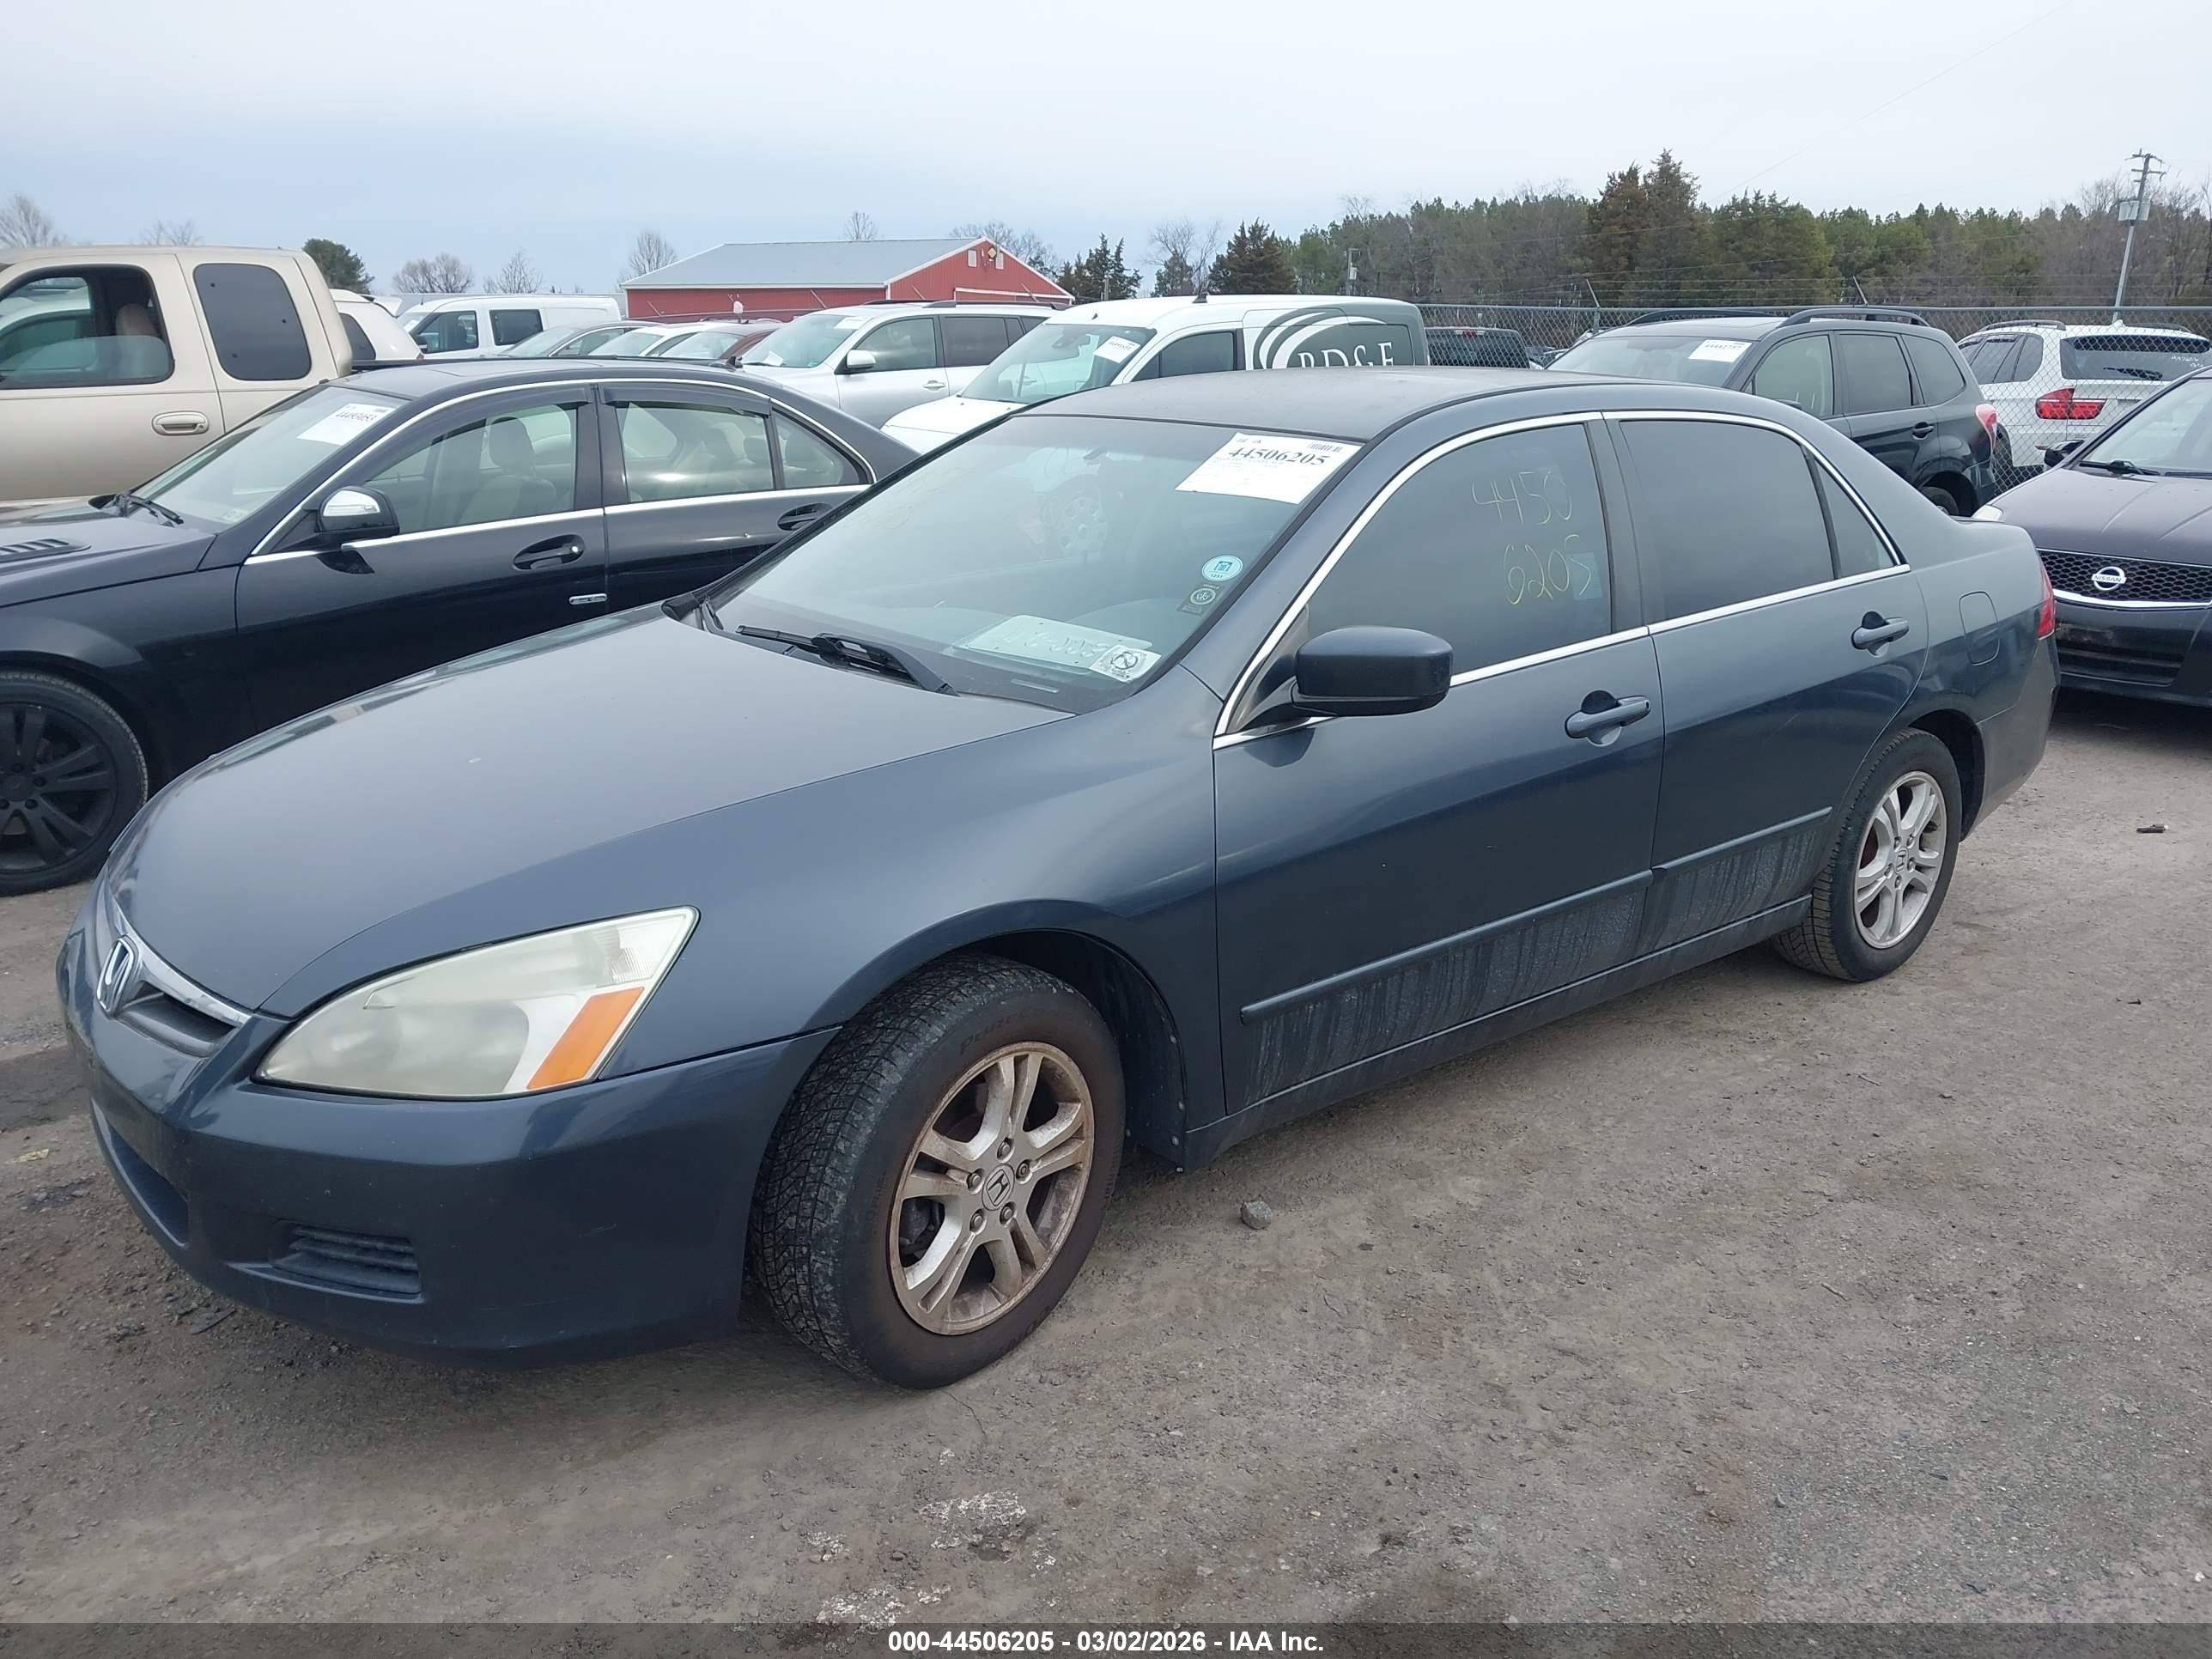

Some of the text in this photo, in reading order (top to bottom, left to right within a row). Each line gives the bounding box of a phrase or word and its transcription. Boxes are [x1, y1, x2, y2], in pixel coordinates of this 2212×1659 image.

[1229, 447, 1331, 465] 44506205
[1471, 470, 1572, 526] 4450
[1504, 533, 1592, 605] 6205
